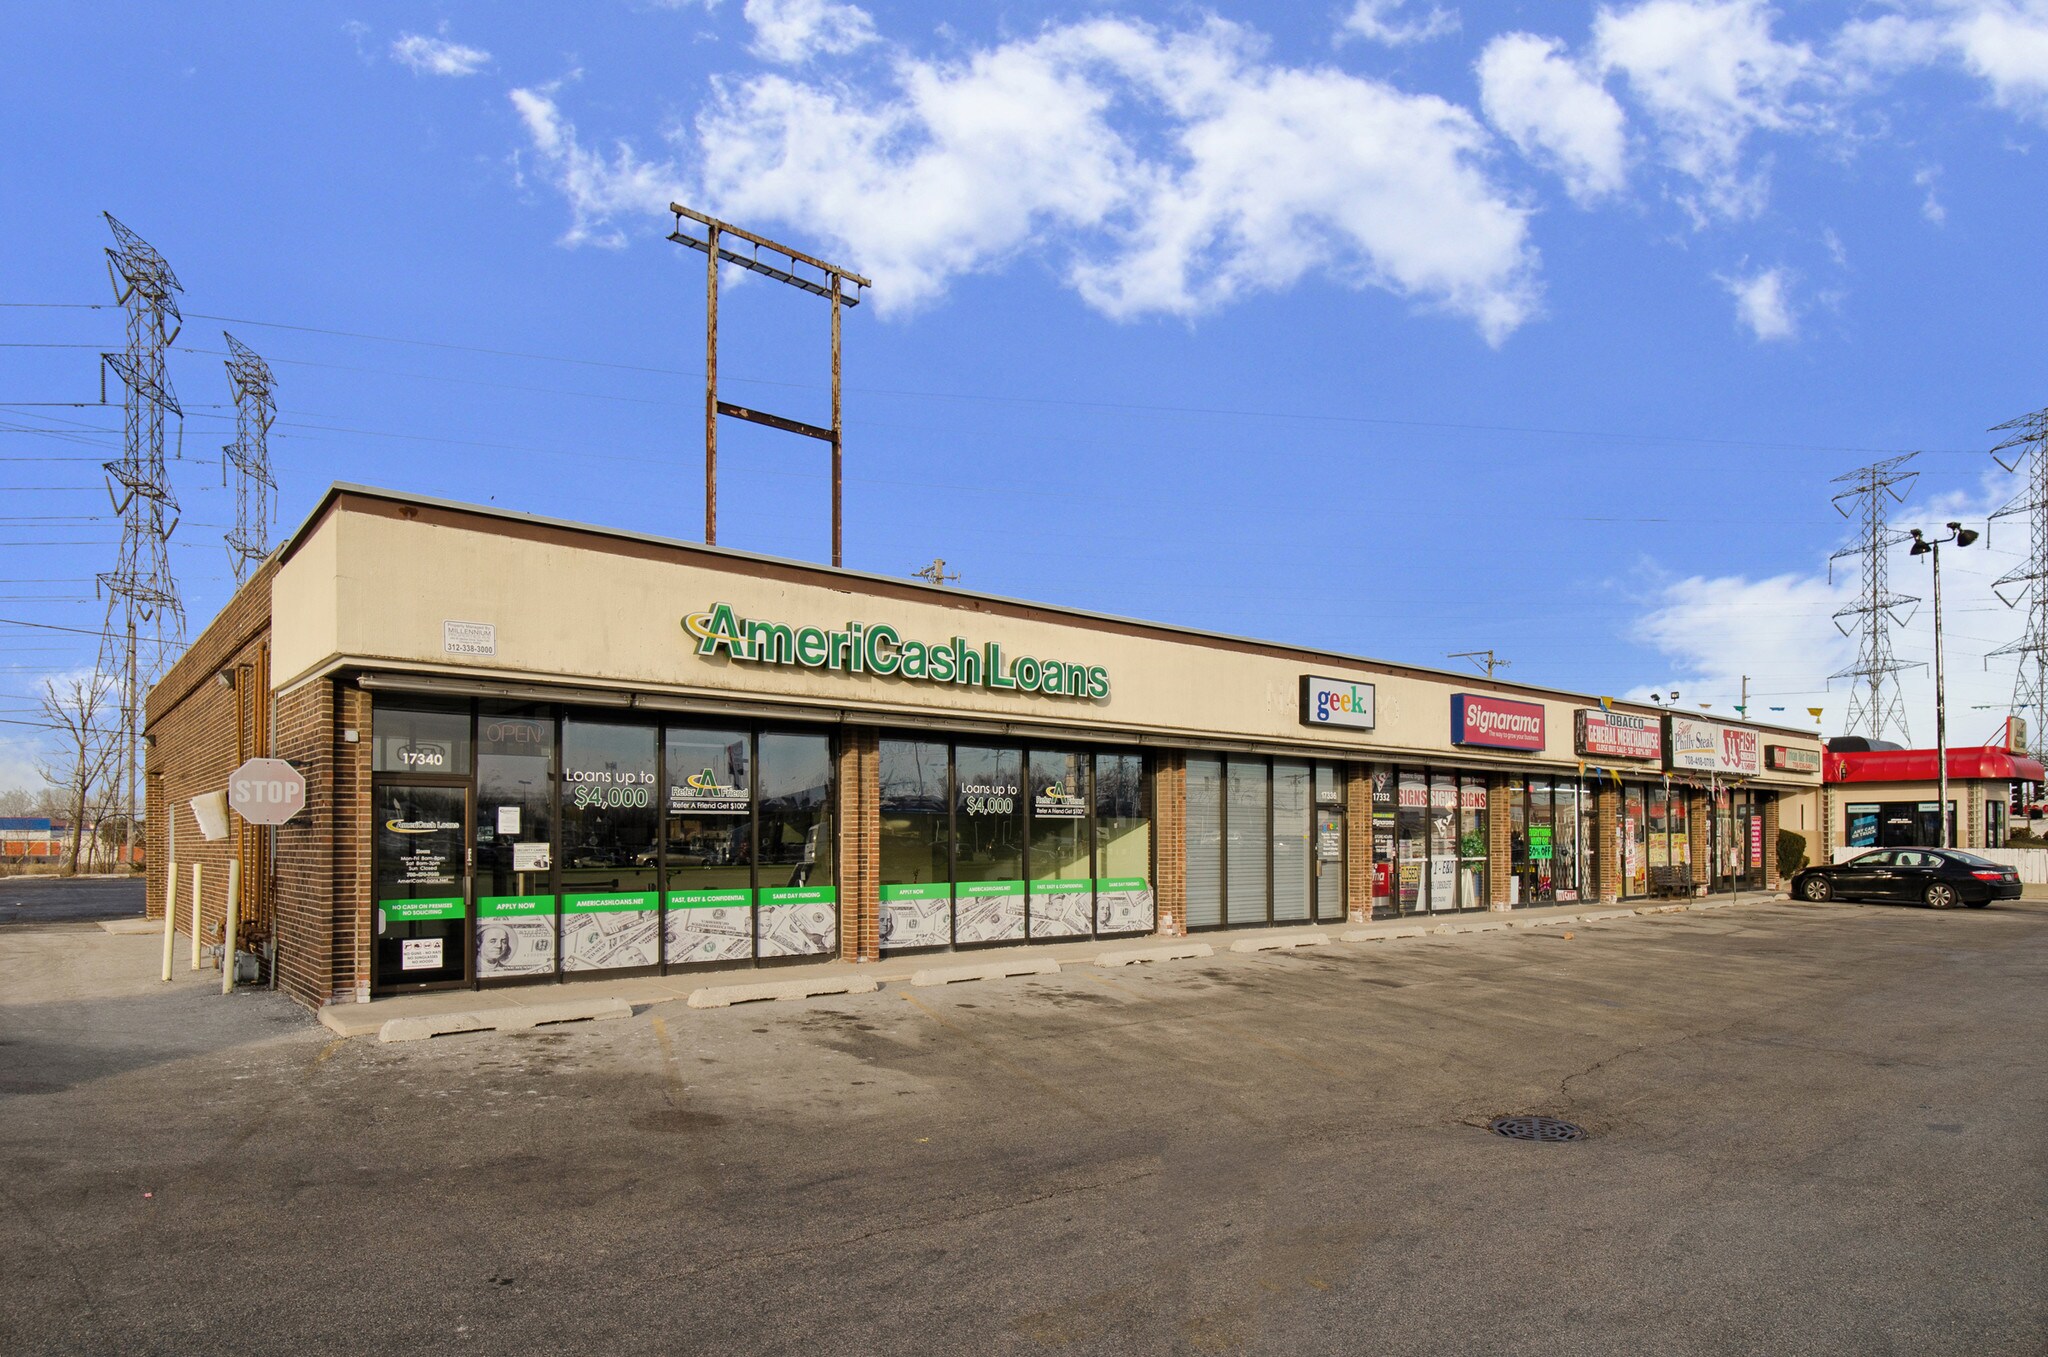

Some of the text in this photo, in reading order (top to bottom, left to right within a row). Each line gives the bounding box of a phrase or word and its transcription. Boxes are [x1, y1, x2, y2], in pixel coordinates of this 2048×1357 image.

[448, 627, 491, 637] MILLENNIUM
[448, 643, 493, 653] 312-338-3000
[684, 601, 1111, 699] AmeriCash Loans
[1467, 704, 1541, 734] Signarama
[1604, 713, 1644, 730] TOBACCO
[487, 724, 542, 743] OPEN
[1588, 724, 1617, 745] GENERAL
[1617, 728, 1659, 750] MERCHANDISE
[1675, 731, 1714, 752] Philly Steak
[1740, 732, 1756, 751] FISH
[402, 753, 443, 765] 17340
[566, 768, 655, 785] Loans up to
[235, 780, 300, 804] STOP
[574, 785, 649, 810] $4,000
[671, 786, 696, 797] Refer
[720, 787, 748, 798] Friend
[961, 782, 1018, 797] Loans up to
[1373, 792, 1390, 802] 17332
[1399, 788, 1427, 806] SIGNS
[672, 801, 690, 809] Refer
[697, 801, 717, 809] Friend
[966, 795, 1014, 816] $4,000
[1431, 790, 1457, 807] SIGNS
[1461, 791, 1486, 808] SIGNS
[437, 821, 460, 830] Loans
[1529, 846, 1551, 857] 50% OFF
[576, 898, 644, 907] AMERICASHLOANS.NET
